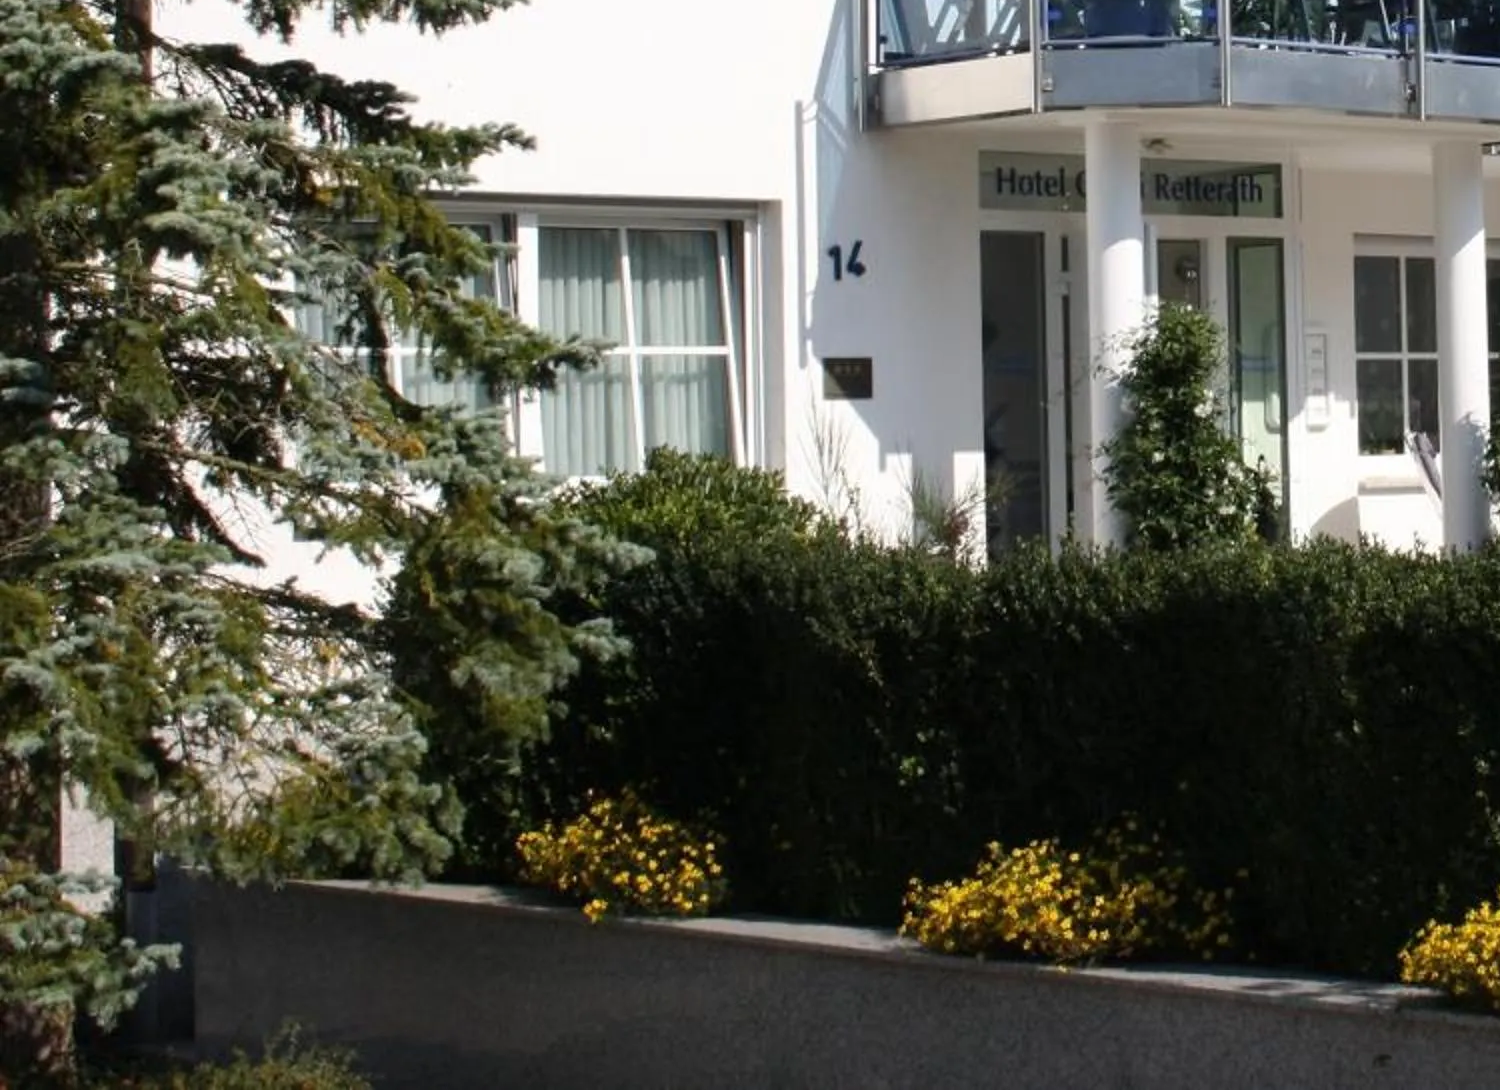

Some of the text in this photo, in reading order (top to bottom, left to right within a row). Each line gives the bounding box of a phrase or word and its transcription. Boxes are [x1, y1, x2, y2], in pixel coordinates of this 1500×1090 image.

[996, 165, 1066, 198] Hotel
[1155, 172, 1263, 203] Retterath
[827, 239, 867, 282] 16
